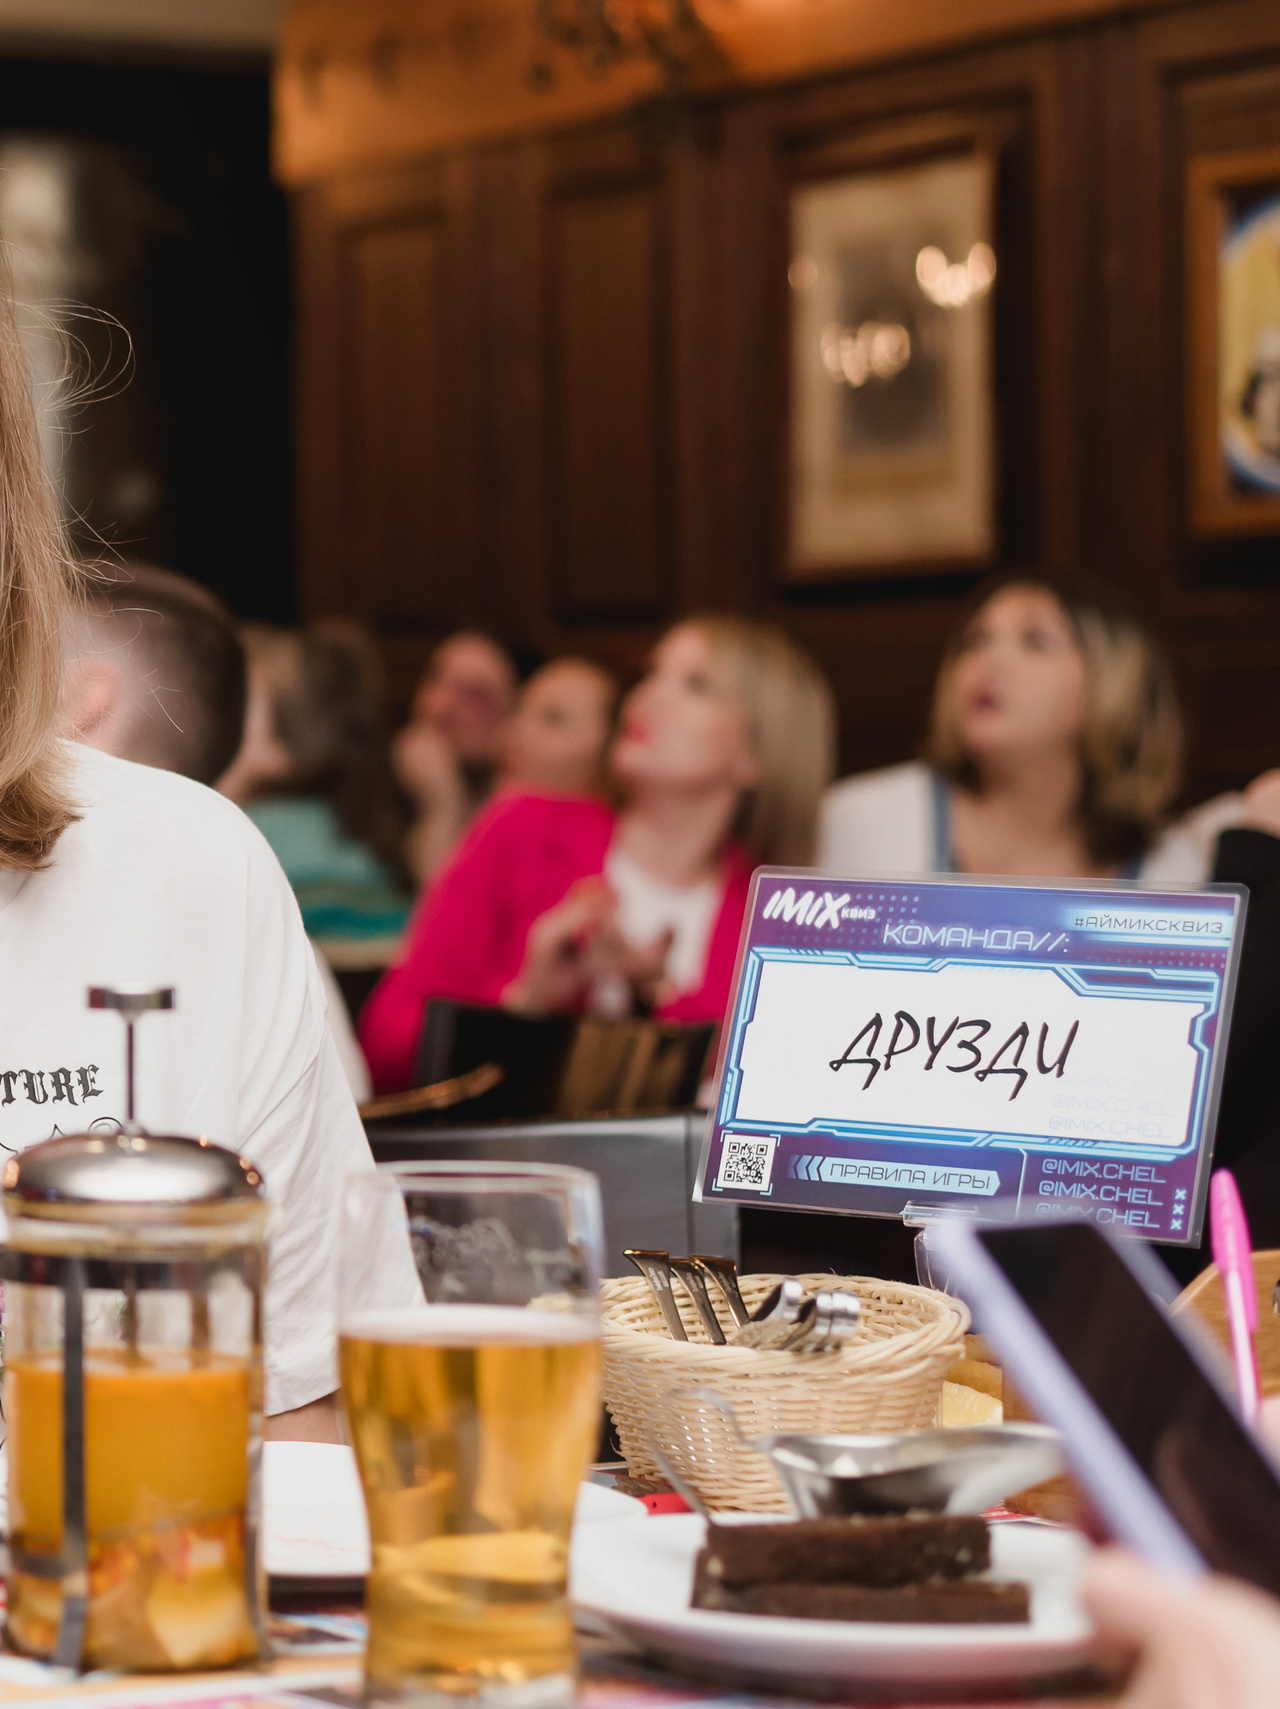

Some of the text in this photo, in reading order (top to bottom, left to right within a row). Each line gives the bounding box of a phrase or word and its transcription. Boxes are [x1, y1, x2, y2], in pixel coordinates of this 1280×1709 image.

[1073, 914, 1223, 934] #АЙМИКСКВИЗ
[829, 1010, 1080, 1101] ДРУЗДИ
[830, 1163, 991, 1190] ПРАВИЛА ИГРЫ
[1042, 1158, 1167, 1184] @IMIX.CHEL
[1038, 1180, 1164, 1206] @IMIX.CHEL
